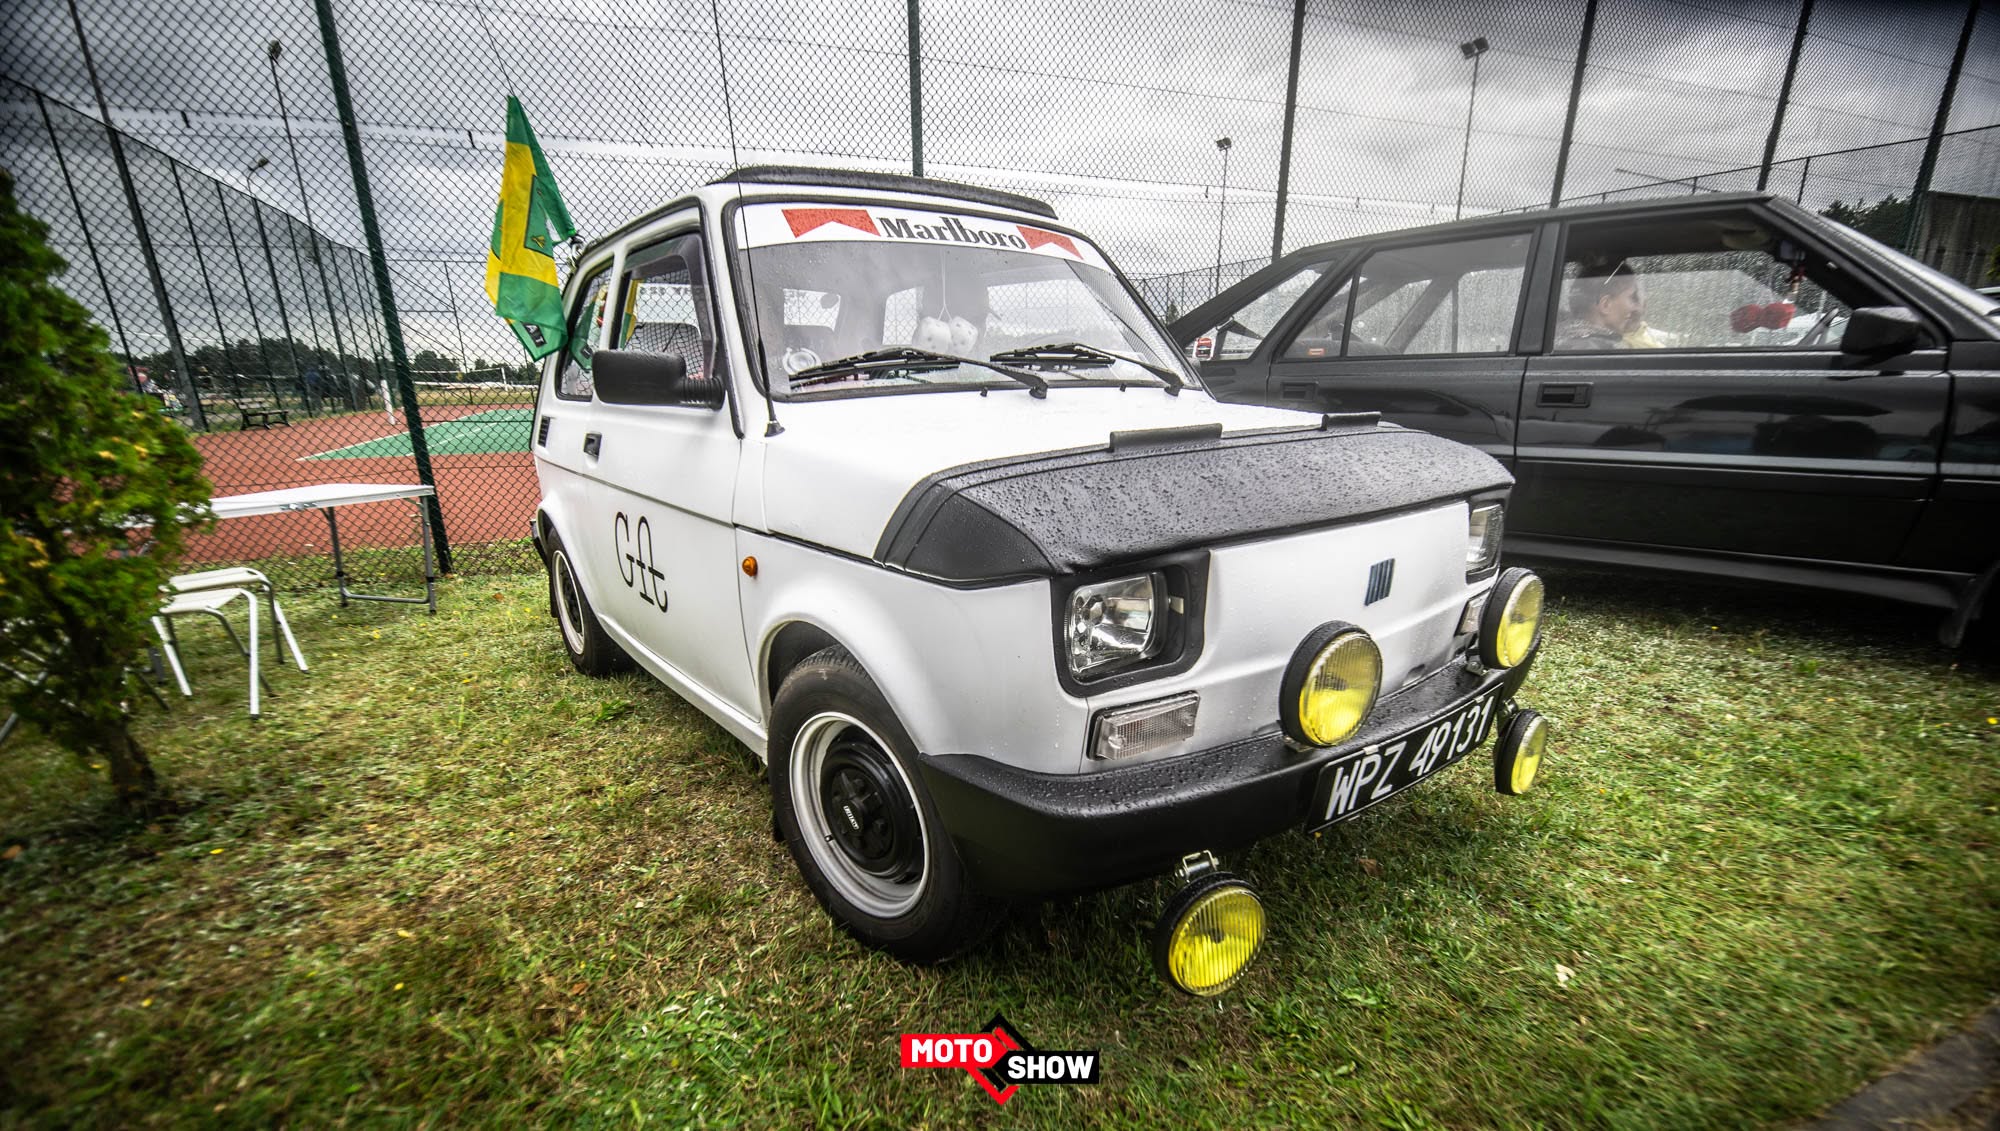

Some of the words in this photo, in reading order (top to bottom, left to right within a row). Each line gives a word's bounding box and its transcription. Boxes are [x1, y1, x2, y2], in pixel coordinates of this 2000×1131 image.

[877, 216, 1027, 249] Marlboro
[1325, 741, 1407, 820] WPZ
[1409, 696, 1494, 777] 49131
